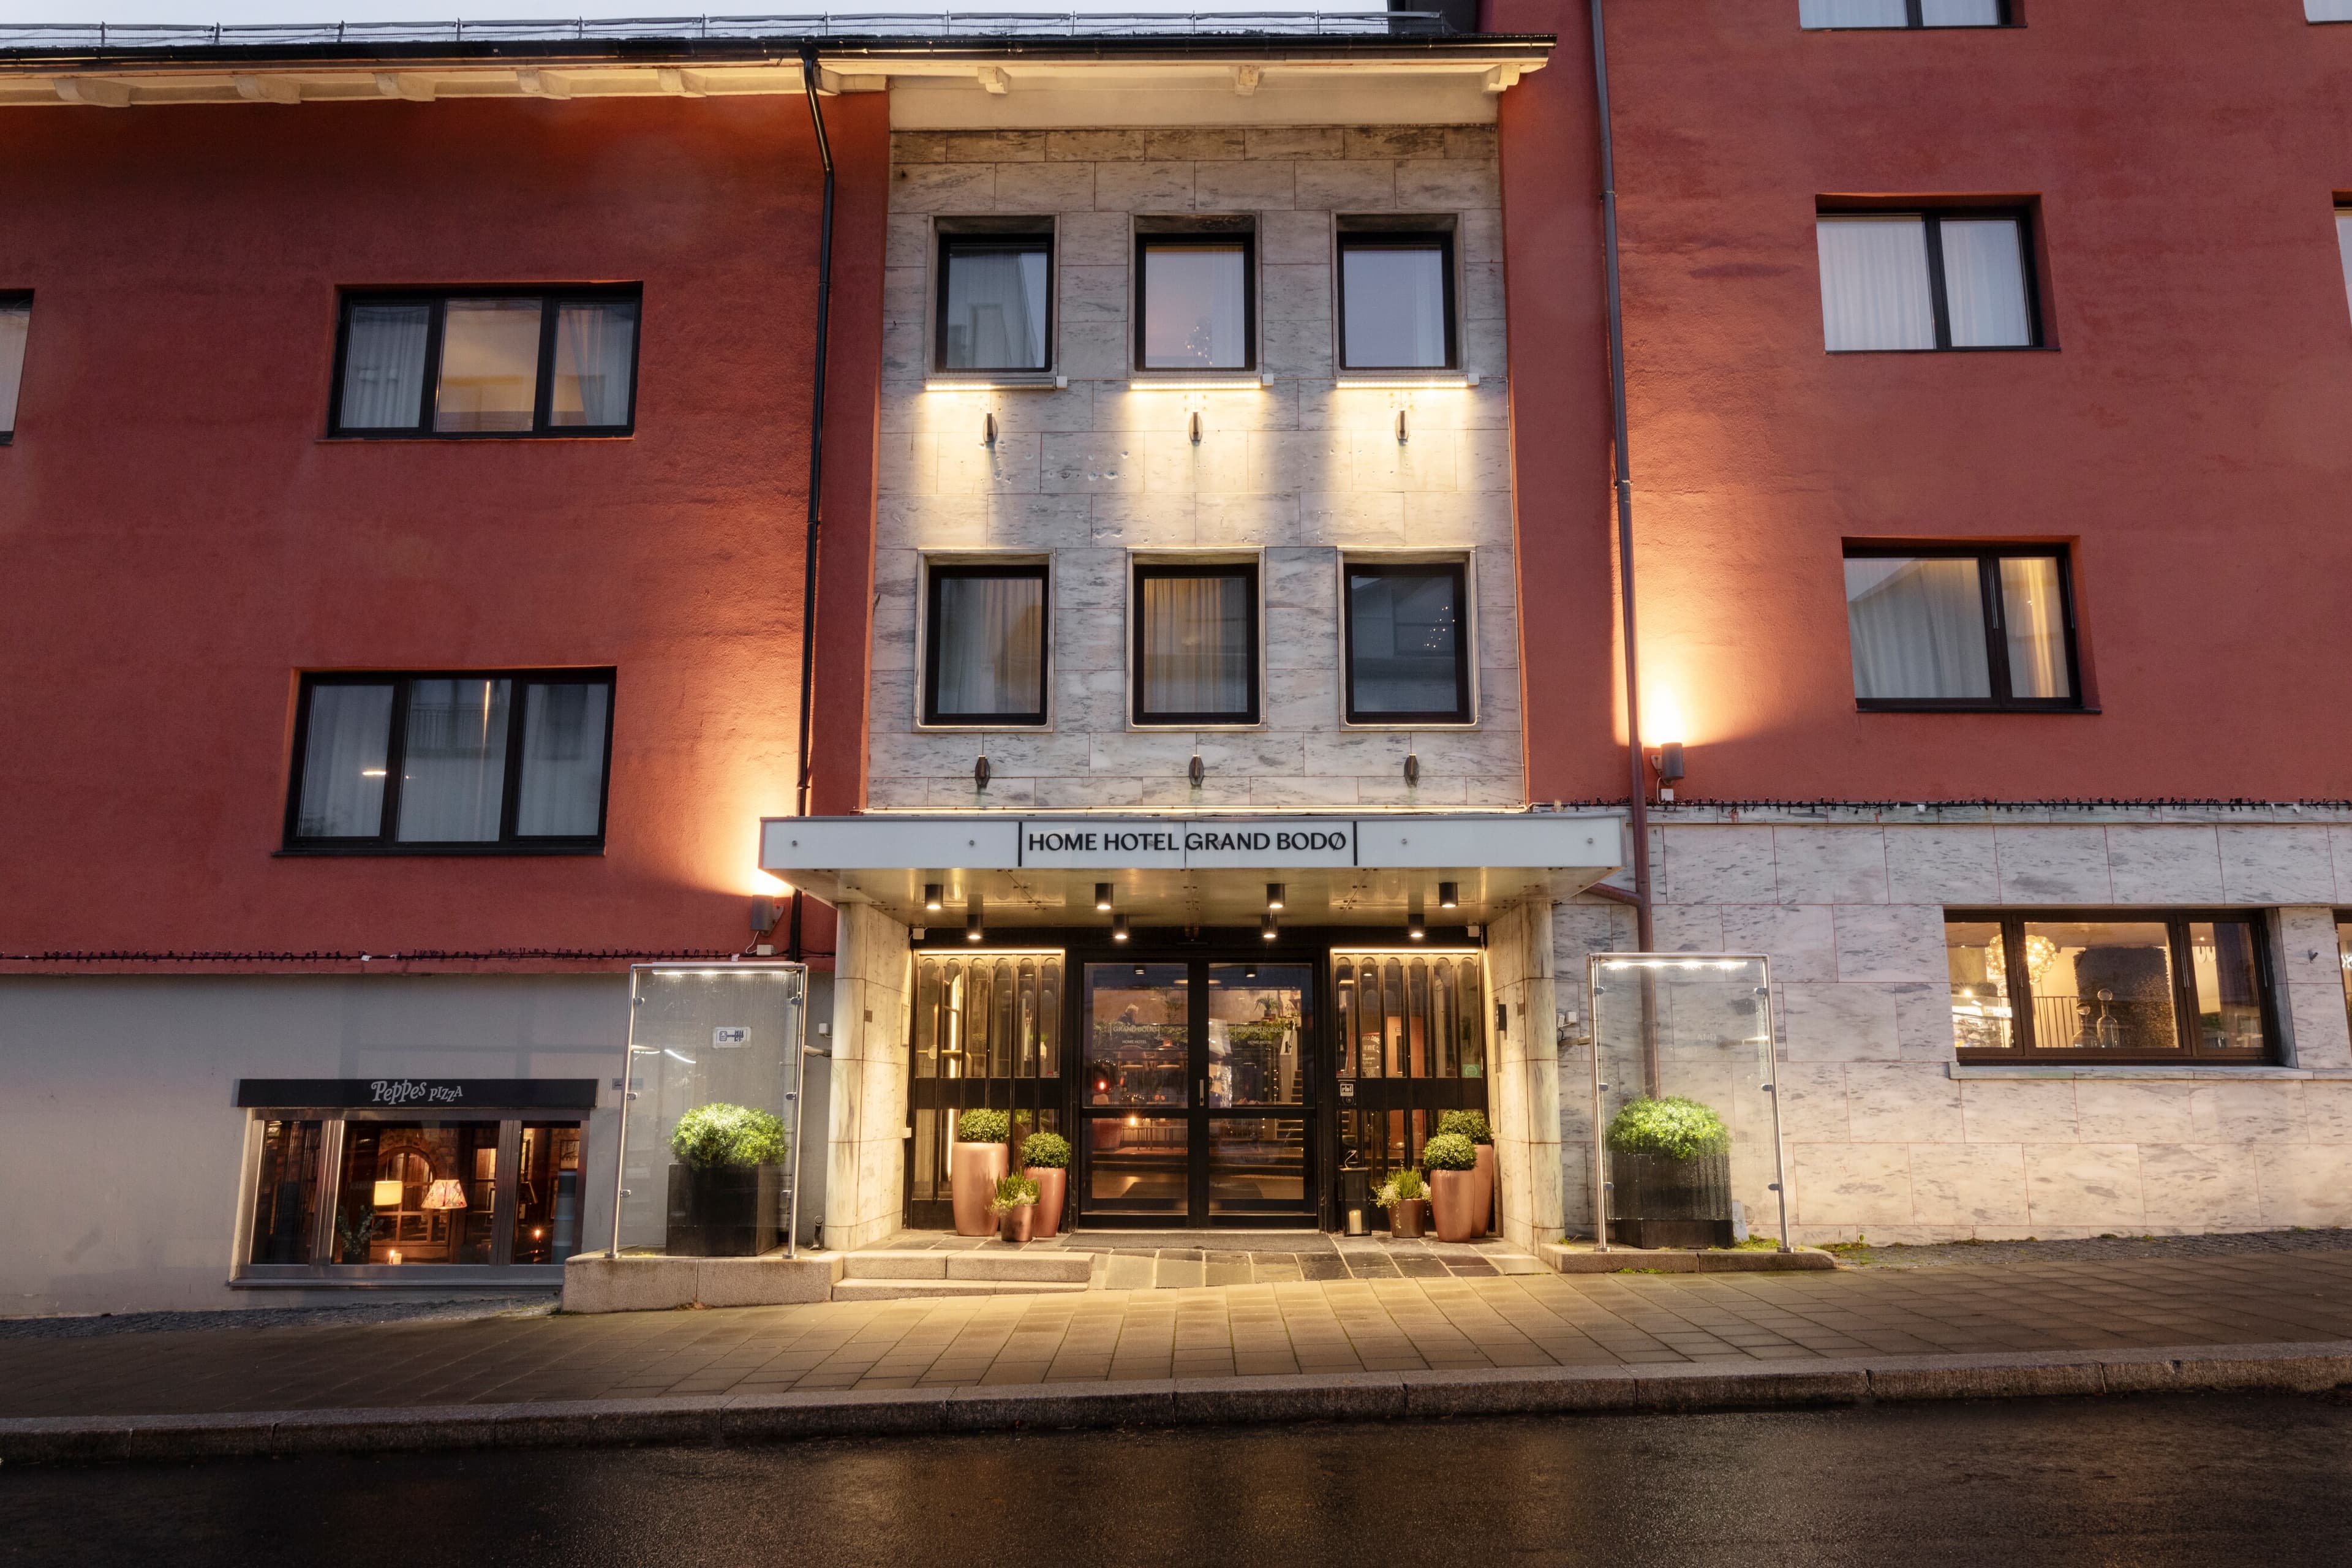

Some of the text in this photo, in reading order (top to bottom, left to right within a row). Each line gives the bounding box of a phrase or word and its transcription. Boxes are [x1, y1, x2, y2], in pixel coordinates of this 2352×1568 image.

[1029, 831, 1346, 851] HOME HOTEL GRAND BODØ
[371, 1079, 427, 1104] Peppes
